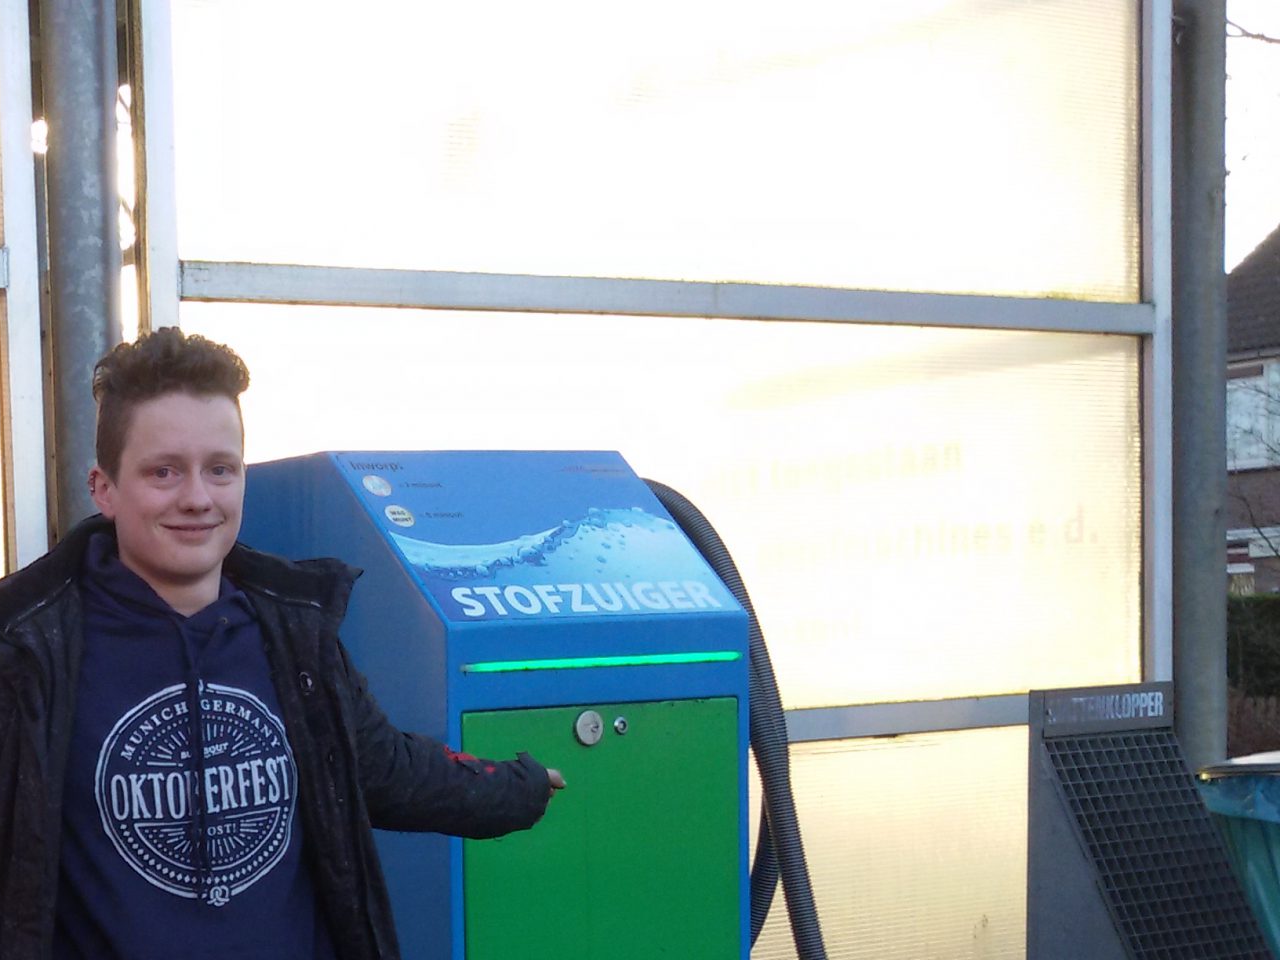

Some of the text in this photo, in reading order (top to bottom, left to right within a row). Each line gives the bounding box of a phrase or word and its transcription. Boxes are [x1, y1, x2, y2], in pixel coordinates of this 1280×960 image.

[451, 581, 721, 617] STOFZUIGER
[120, 698, 281, 761] MUNICH GERMANY
